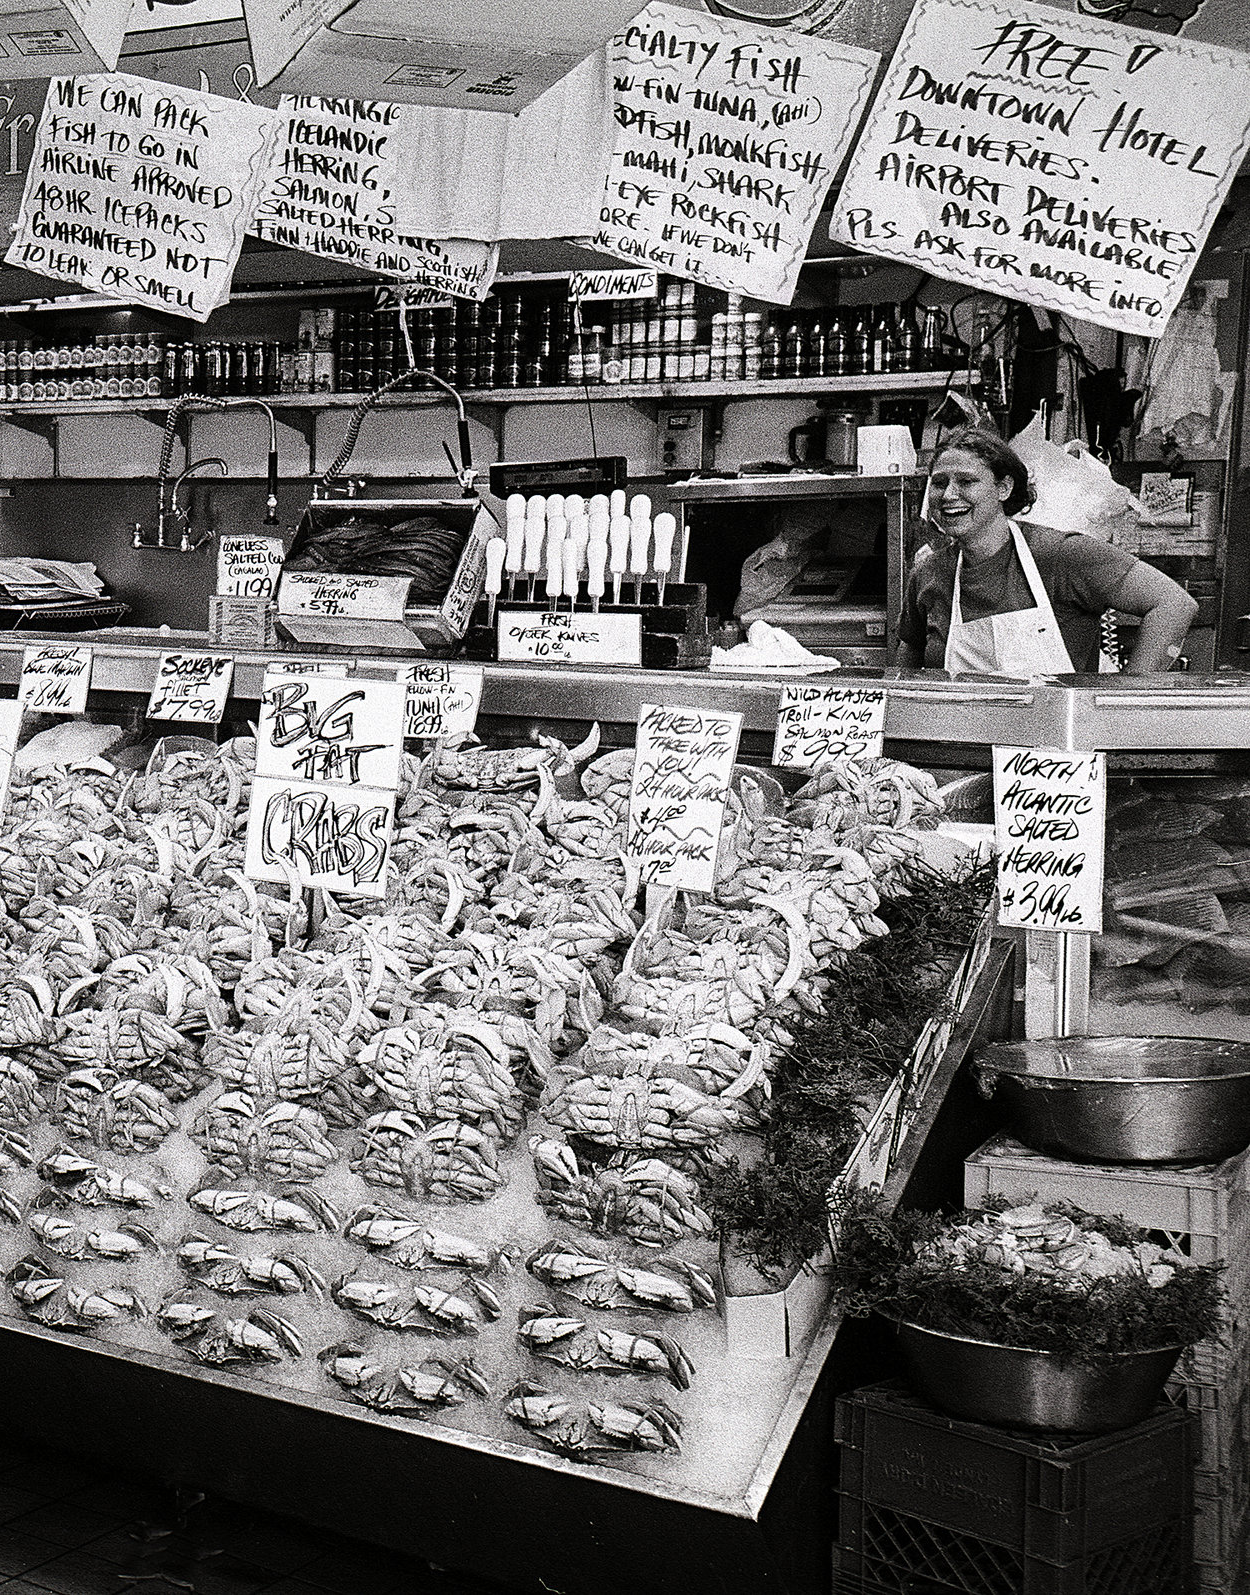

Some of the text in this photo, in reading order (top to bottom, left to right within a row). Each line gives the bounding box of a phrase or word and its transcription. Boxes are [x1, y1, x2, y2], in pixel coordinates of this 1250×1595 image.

[724, 43, 809, 94] FISH
[57, 76, 209, 138] WE CAN PACK
[897, 64, 1220, 178] DOWNTOWN HOTEL
[50, 113, 199, 170] FISH TO GO IN
[288, 118, 388, 160] ICELANDIC
[40, 147, 120, 183] AIRLINE
[697, 132, 827, 185] MONKFISH
[696, 167, 796, 215] SHARK
[875, 152, 1197, 254] AIRPORT DELIVERIES
[104, 197, 208, 244] ICEPACKS
[258, 199, 335, 229] SALTED
[671, 192, 792, 253] ROCKFISH
[32, 211, 229, 279] GUARANTEED NOT
[252, 218, 300, 246] FINN
[374, 251, 411, 272] AND
[618, 236, 650, 259] CAN
[648, 246, 678, 267] GET
[661, 223, 756, 264] IF WE DON'T
[938, 200, 1182, 280] ALSO AVAILABLE
[17, 242, 204, 315] TO LEAK OR SMELL
[571, 269, 656, 296] CONDIMENTS
[913, 228, 966, 261] ASK
[968, 246, 1023, 277] FOR
[1030, 261, 1103, 302] MORE
[415, 269, 479, 298] HERRING
[224, 552, 268, 566] SALTED
[310, 585, 359, 601] HERRING
[346, 577, 380, 589] SALTED
[539, 611, 573, 628] FRESH
[557, 630, 601, 644] KNIVES
[405, 663, 456, 683] FRESH
[786, 686, 885, 703] WILD ALASKA
[261, 682, 366, 748] BIG
[640, 704, 733, 737] PACKED TO
[784, 725, 885, 741] SALMON ROAST
[291, 737, 394, 786] FAT
[648, 736, 732, 761] TAKE WITH
[1002, 751, 1084, 784] NORTH
[635, 776, 661, 798] 24
[660, 781, 697, 801] HOUR
[1000, 779, 1094, 816] ATLANTIC
[260, 788, 390, 888] CRABS
[1007, 814, 1080, 843] SALTED
[627, 832, 714, 862] 48 HOUR PACK
[1001, 844, 1086, 879] HERRING
